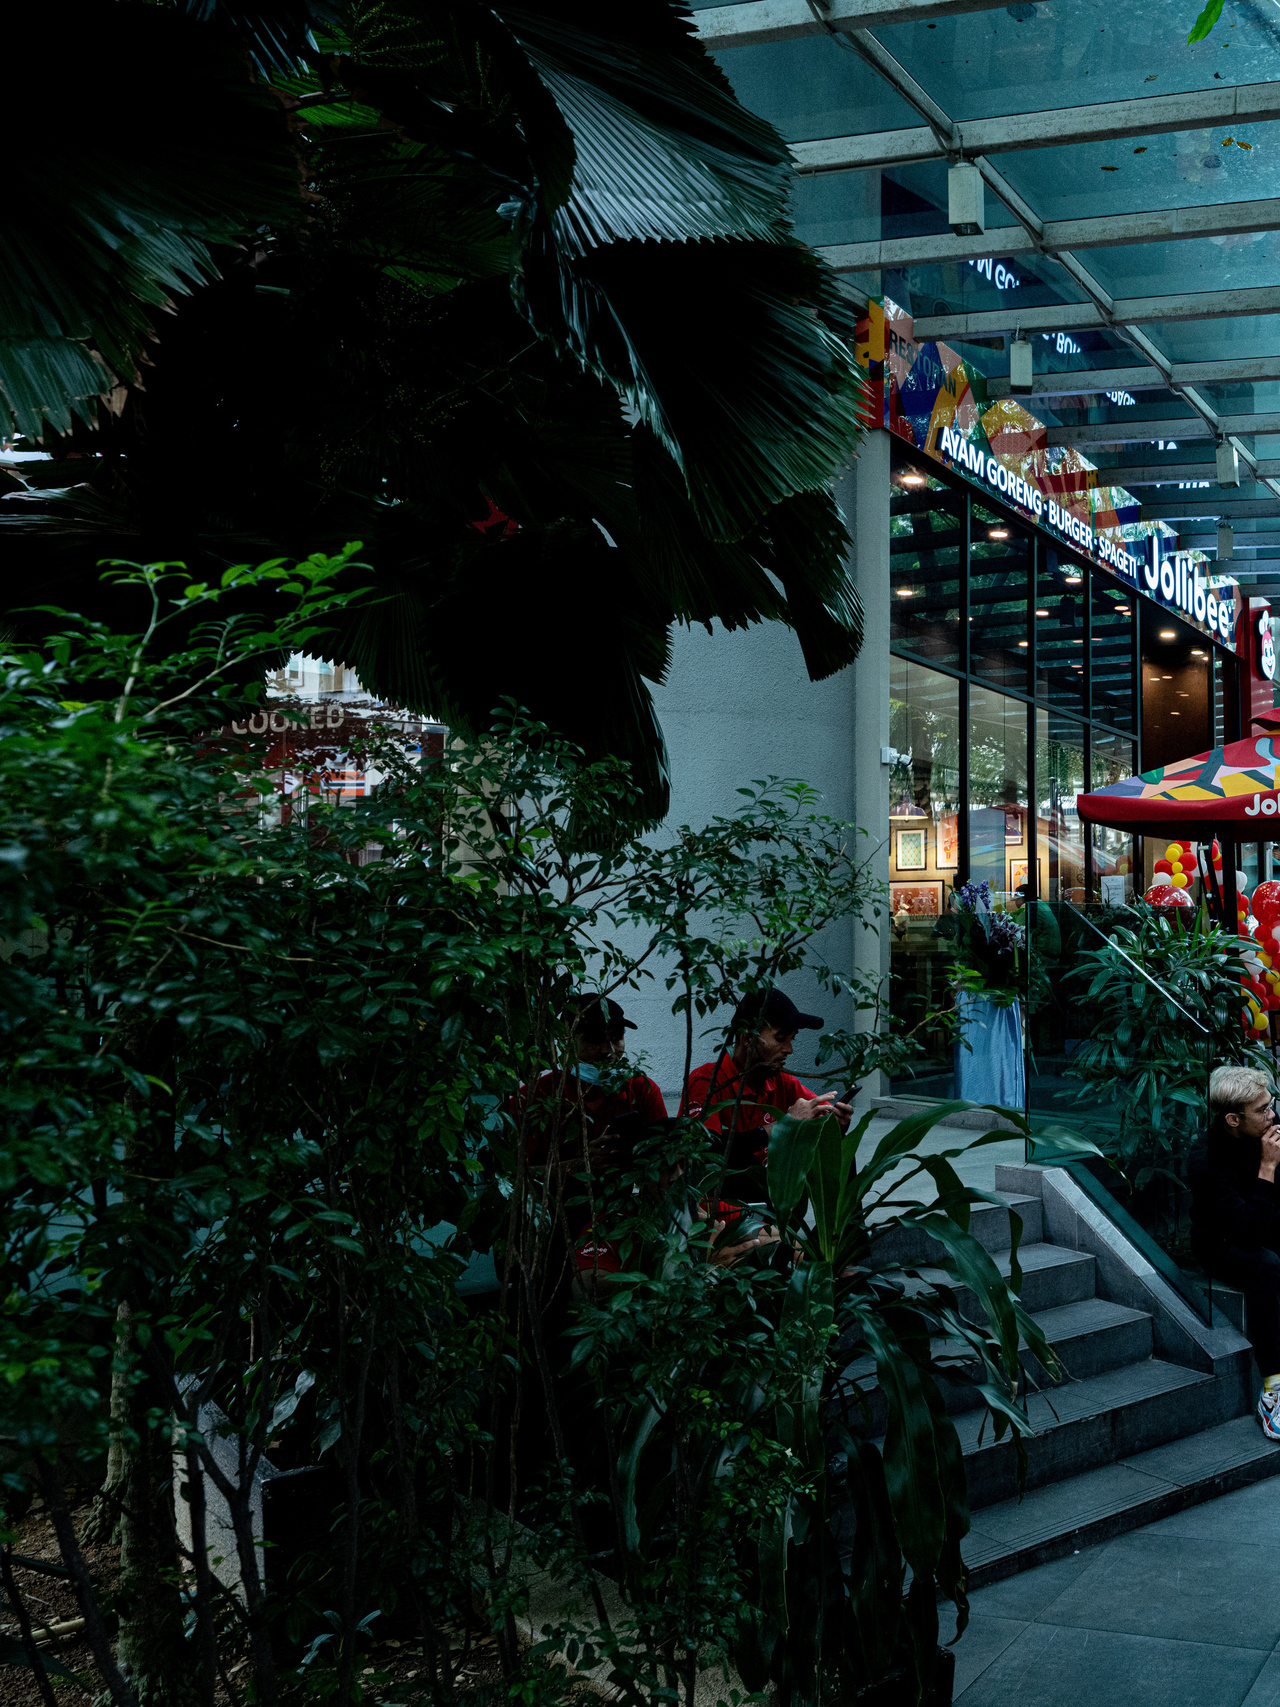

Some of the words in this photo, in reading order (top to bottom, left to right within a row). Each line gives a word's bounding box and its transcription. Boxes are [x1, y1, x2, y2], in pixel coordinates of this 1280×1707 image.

[889, 328, 957, 398] RESTORAN
[941, 426, 984, 477] AYAM
[987, 458, 1042, 515] GORENG
[1048, 500, 1093, 550] BURGER
[1098, 535, 1137, 579] SPAGETI
[1144, 535, 1230, 638] Jollibee
